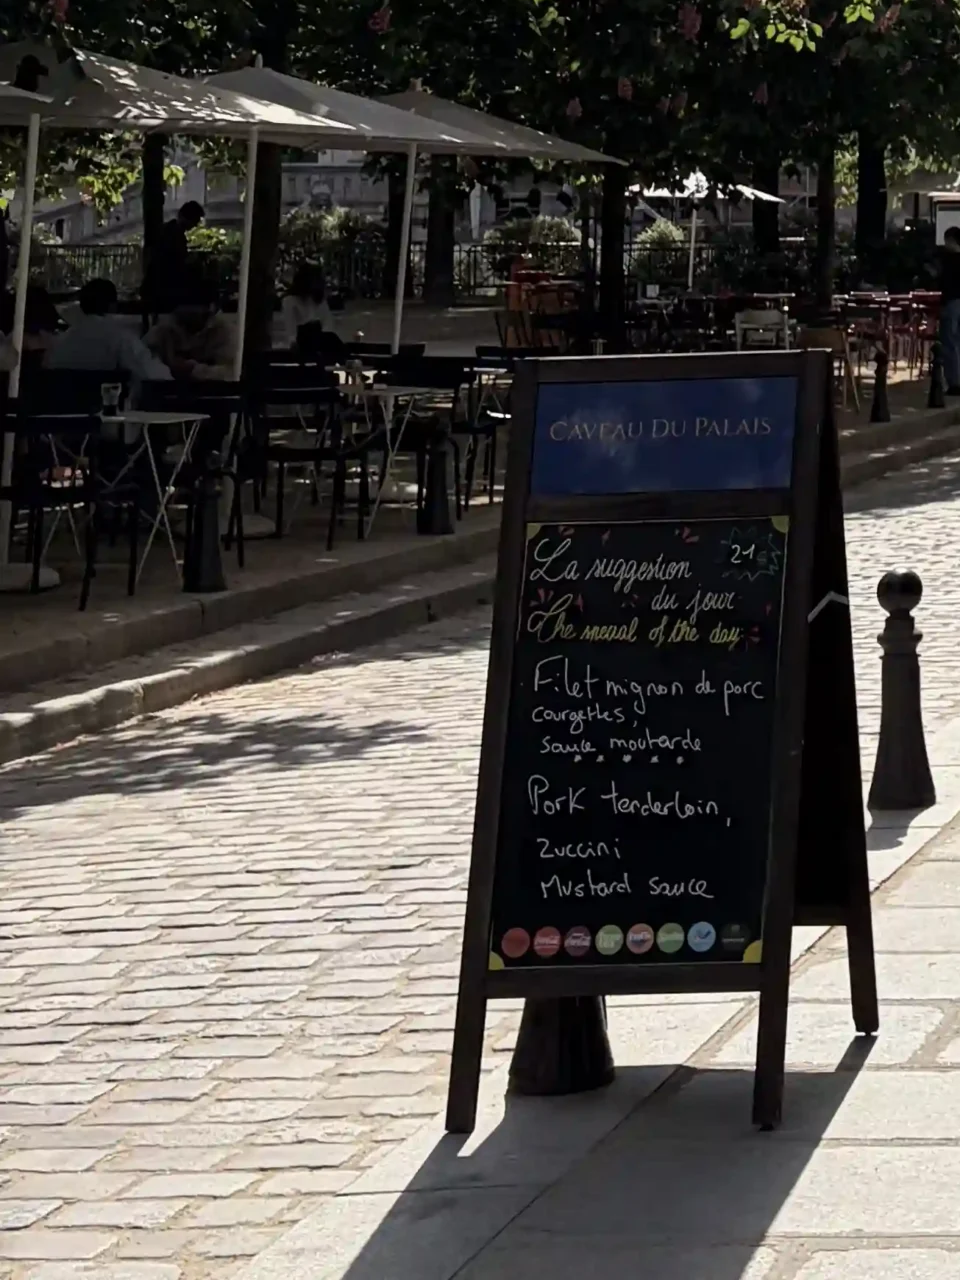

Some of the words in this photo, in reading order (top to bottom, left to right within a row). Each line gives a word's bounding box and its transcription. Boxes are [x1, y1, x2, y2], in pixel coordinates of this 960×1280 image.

[550, 420, 643, 441] CAVEAU
[652, 418, 686, 438] DU
[695, 416, 771, 437] PALAIS
[529, 538, 580, 582] La
[584, 552, 692, 593] suggestion
[527, 593, 576, 643] The
[648, 615, 668, 648] of
[667, 619, 699, 643] the
[651, 584, 679, 611] du
[685, 583, 735, 625] jour
[534, 654, 600, 699] Filet
[606, 678, 684, 715] mignon
[695, 669, 716, 694] de
[724, 680, 764, 716] porc
[610, 727, 701, 751] moutarde
[541, 869, 631, 898] Mustard
